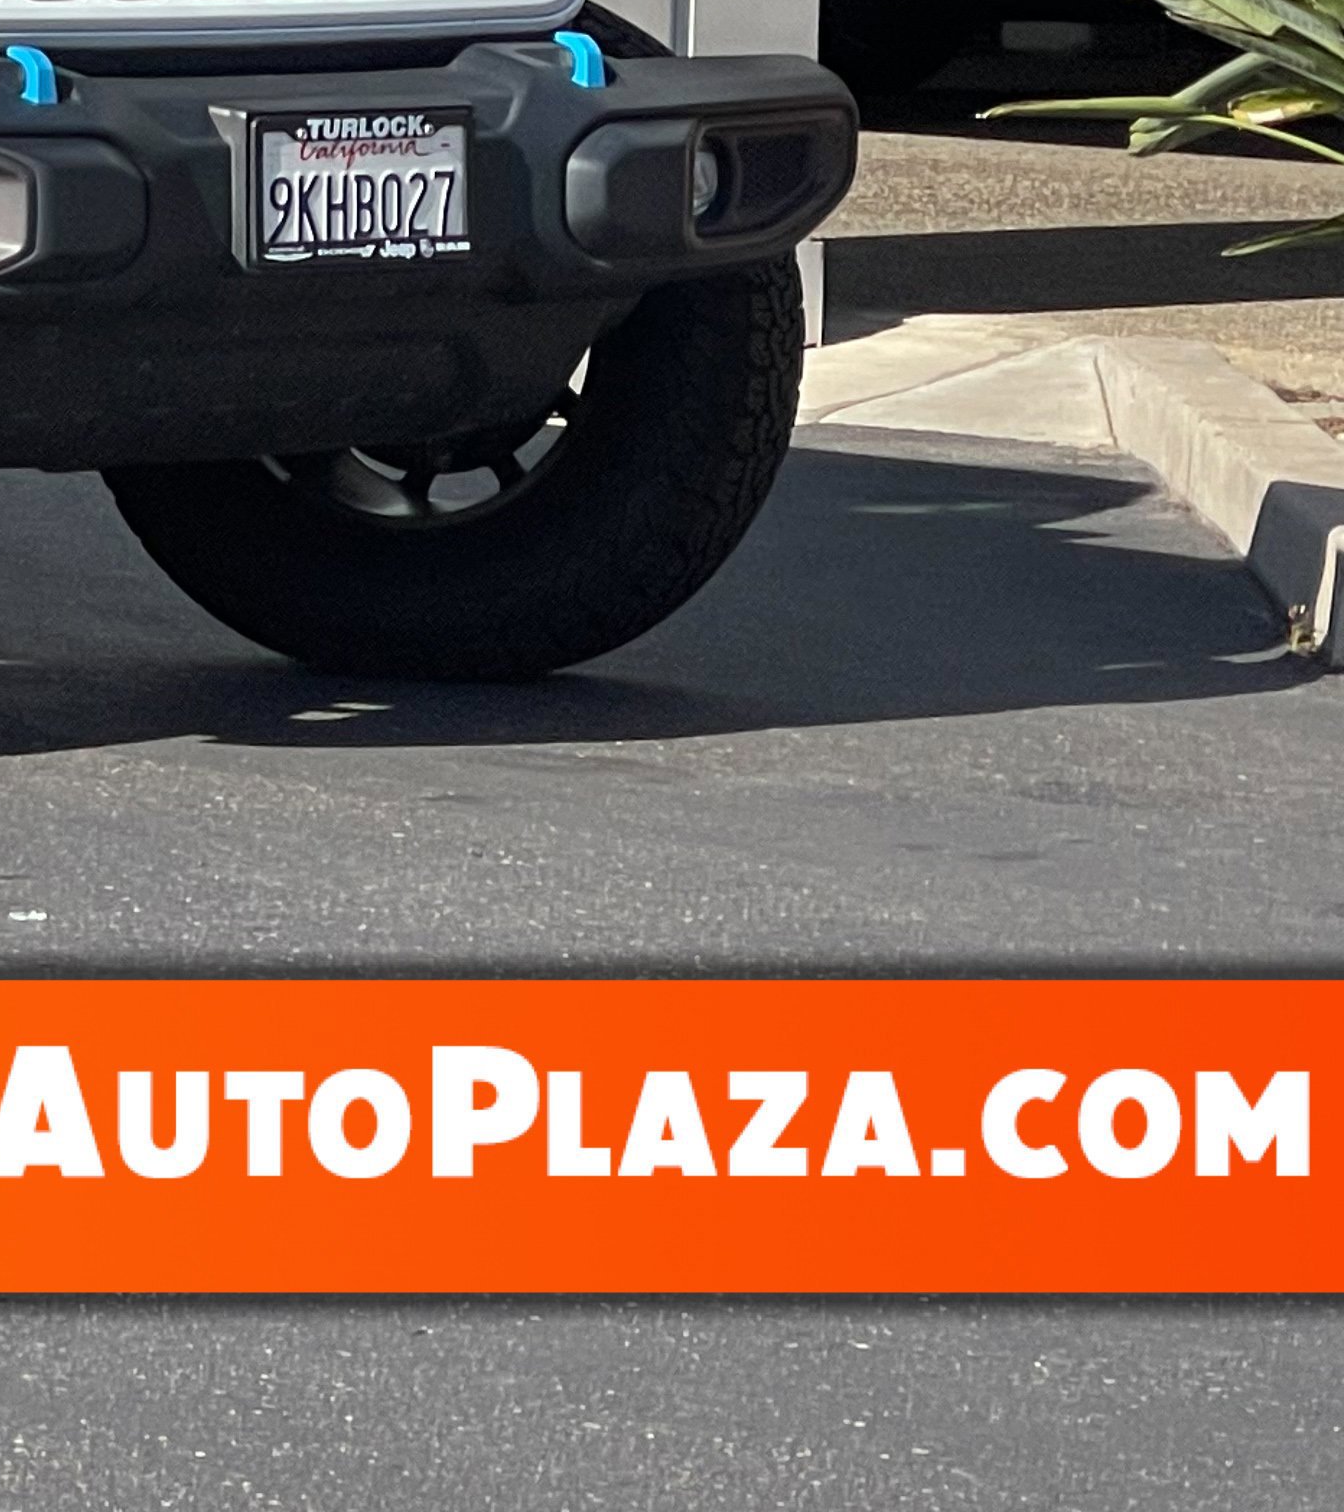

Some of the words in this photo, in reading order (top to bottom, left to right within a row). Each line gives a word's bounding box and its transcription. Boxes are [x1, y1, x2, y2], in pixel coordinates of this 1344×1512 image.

[307, 114, 425, 140] TURLOCK
[298, 139, 430, 170] California
[268, 170, 456, 244] 9KHB027
